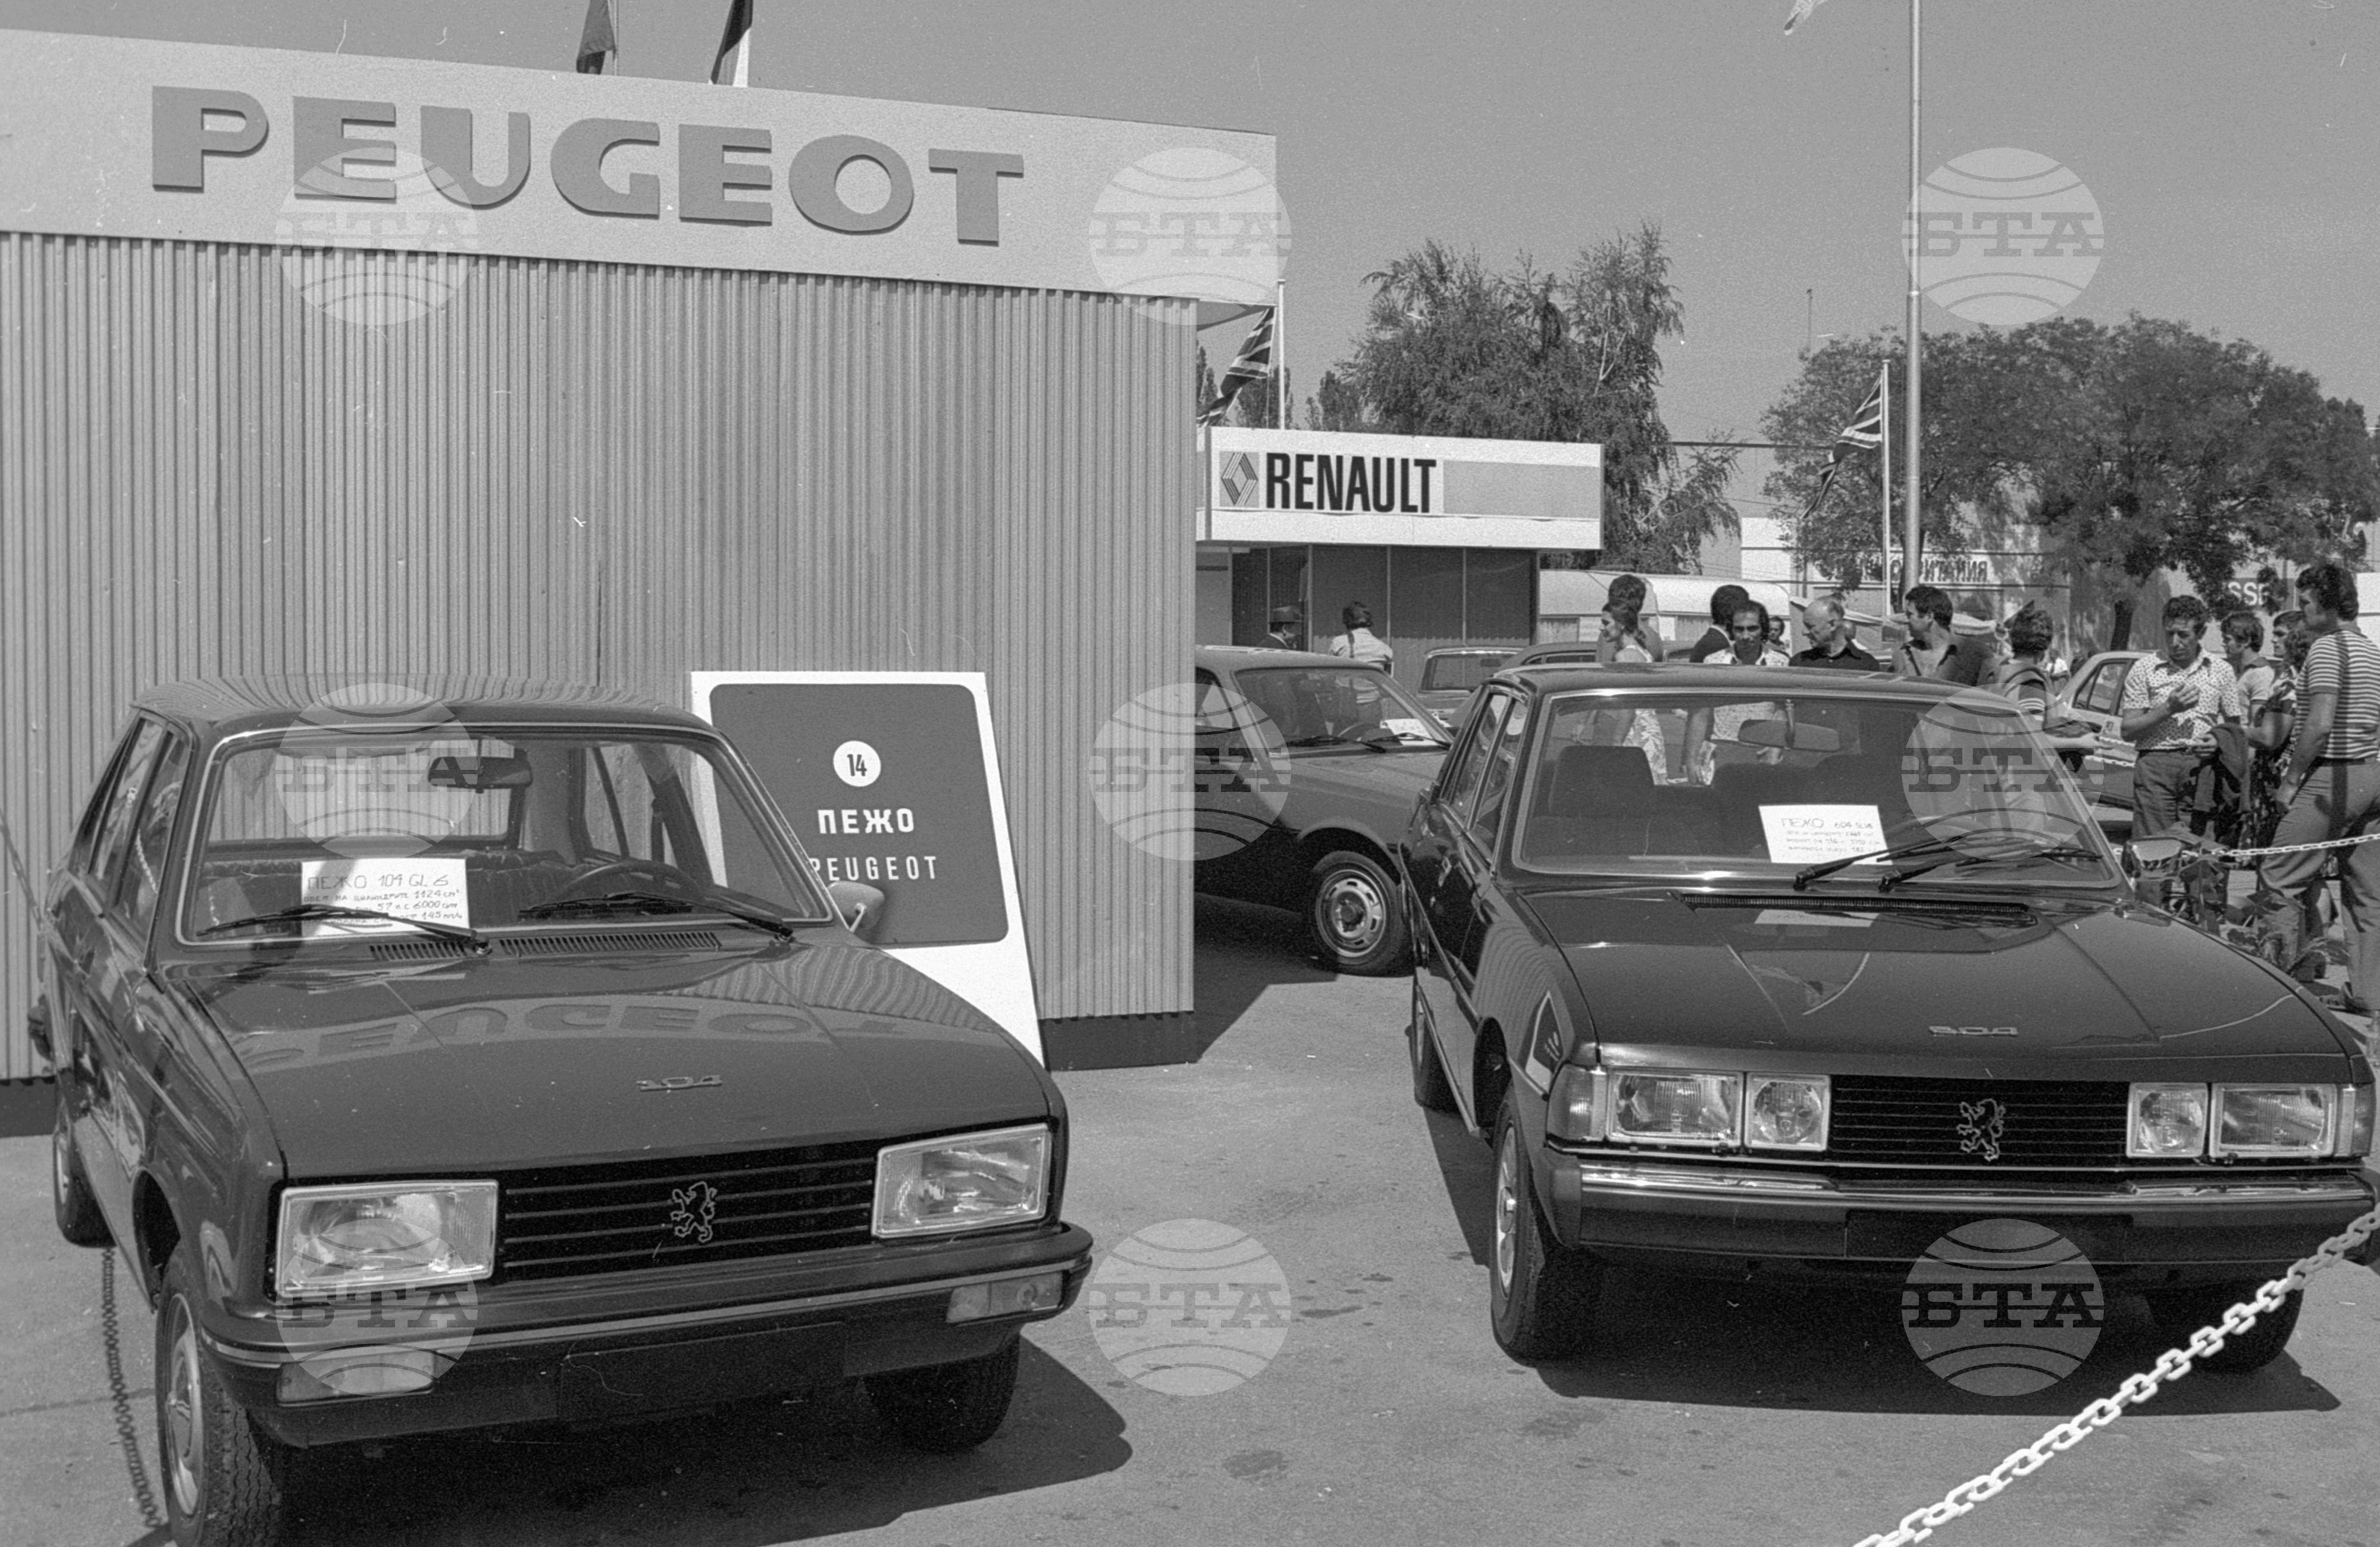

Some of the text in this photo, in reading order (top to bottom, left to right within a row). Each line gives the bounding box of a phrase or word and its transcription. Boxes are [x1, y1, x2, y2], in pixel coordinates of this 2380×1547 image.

[152, 86, 1023, 246] PEUGEOT
[1266, 452, 1436, 513] RENAULT
[847, 753, 867, 776] 14
[818, 808, 914, 834] ПЕЖО
[809, 856, 936, 881] PEUGEOT
[308, 875, 367, 889] ПЕЖО
[378, 874, 403, 887] 104
[409, 874, 428, 887] GL
[1929, 1026, 2018, 1036] 604
[636, 1075, 722, 1091] 104
